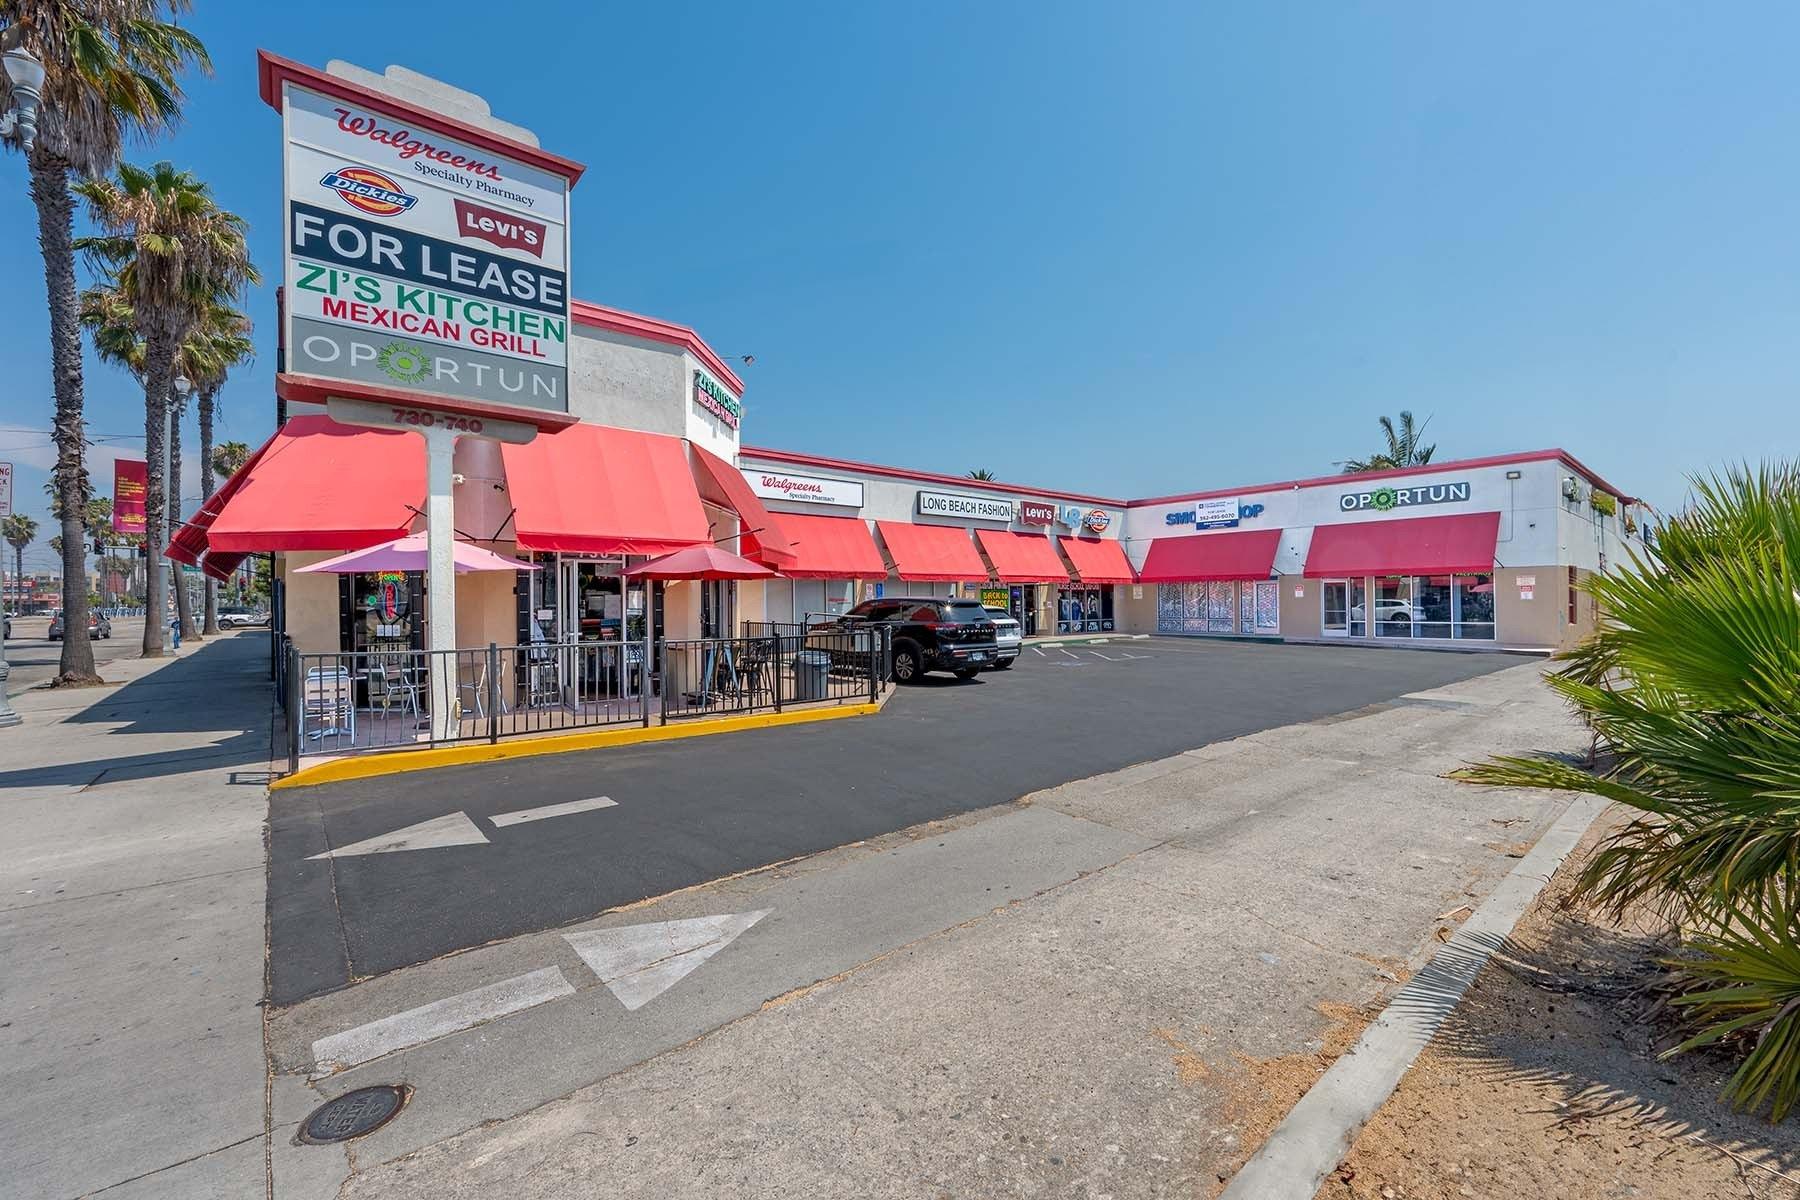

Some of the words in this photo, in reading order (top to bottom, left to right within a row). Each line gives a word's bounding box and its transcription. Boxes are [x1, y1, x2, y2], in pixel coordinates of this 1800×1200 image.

[333, 107, 503, 182] Walgreens
[332, 177, 409, 206] Dickies
[414, 161, 472, 189] Specialty
[476, 179, 535, 208] Pharmacy
[466, 212, 539, 246] Levi's
[295, 212, 405, 271] FOR
[421, 245, 563, 308] LEASE
[296, 262, 382, 305] ZI'S
[396, 284, 565, 344] KITCHEN
[322, 296, 461, 342] MEXICAN
[470, 327, 546, 358] GRILL
[302, 335, 557, 399] OPORTUN
[391, 408, 484, 433] 730-740
[761, 476, 823, 493] Walgreens
[811, 494, 835, 502] Pharmacy
[1341, 483, 1467, 511] OPORTUN
[922, 497, 947, 511] LONG
[949, 500, 977, 514] BEACH
[978, 503, 1010, 517] FASHION
[1166, 510, 1197, 526] SMO
